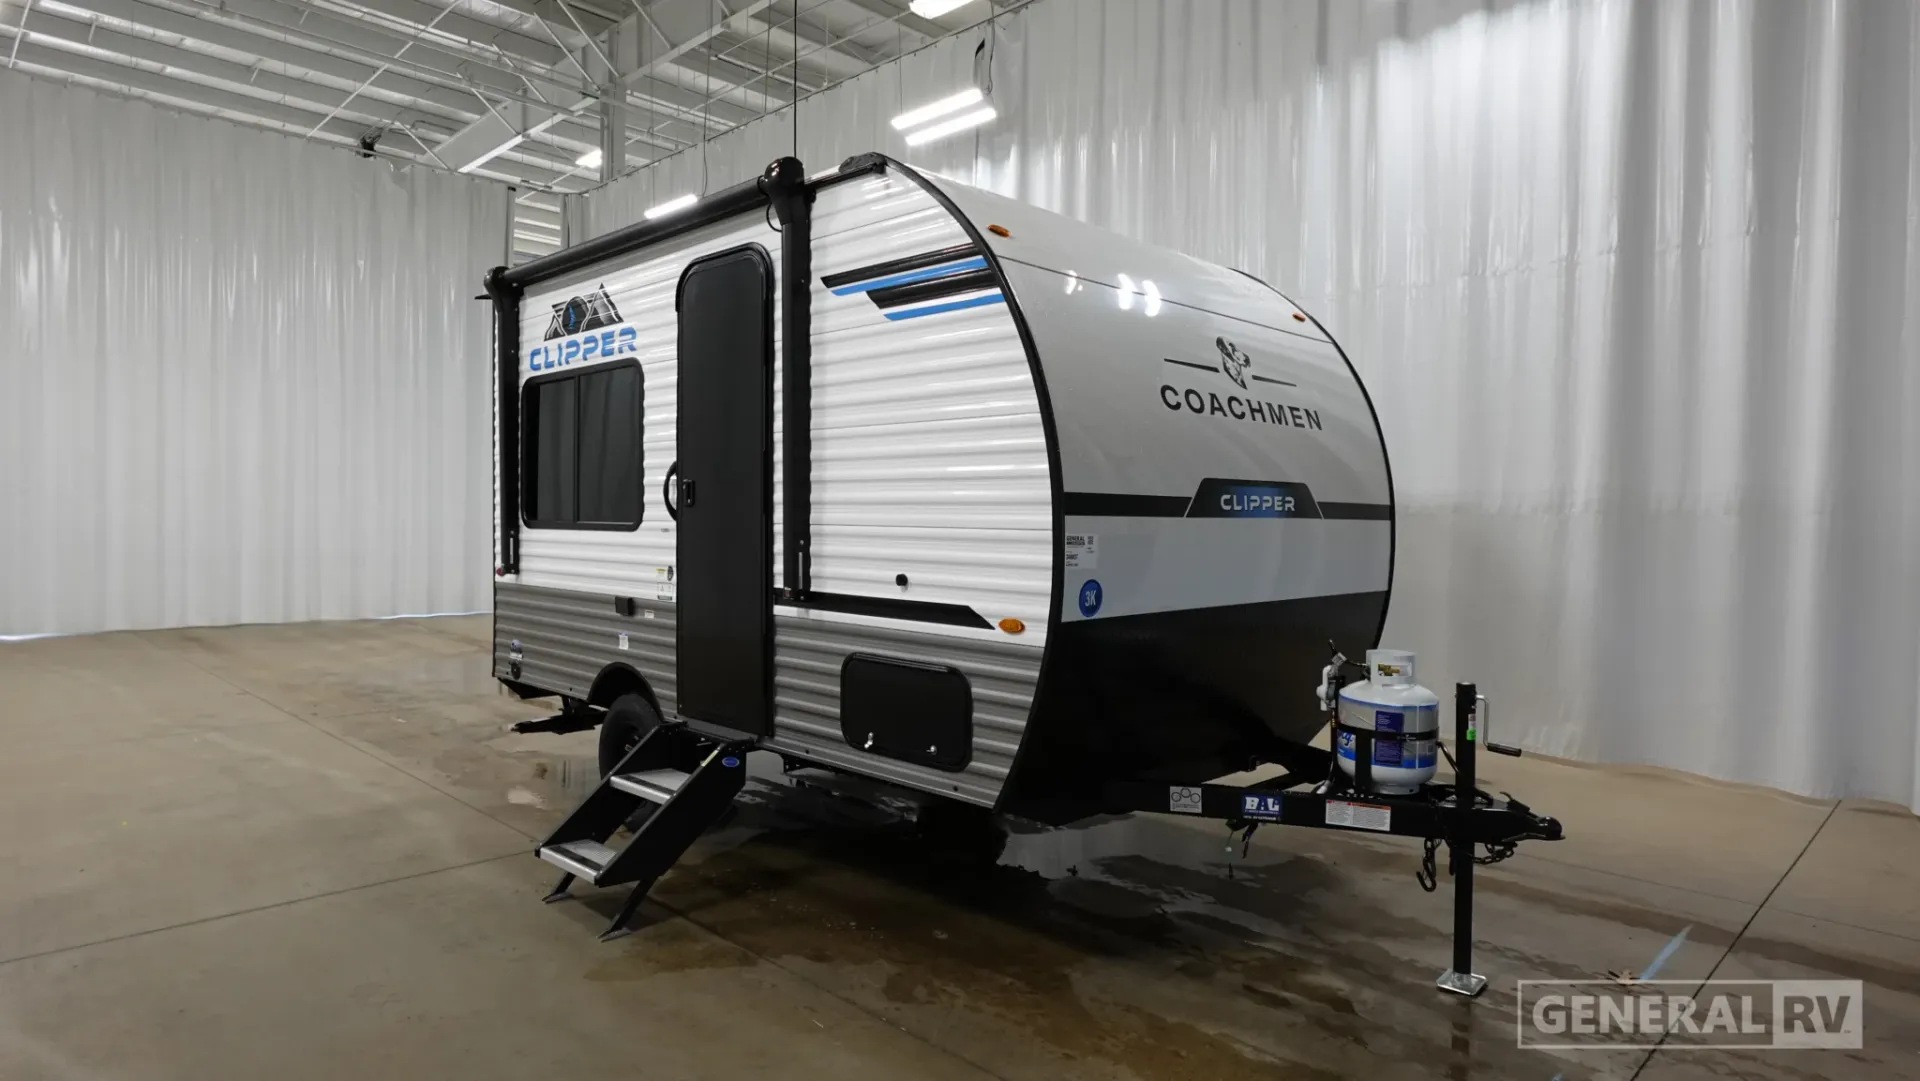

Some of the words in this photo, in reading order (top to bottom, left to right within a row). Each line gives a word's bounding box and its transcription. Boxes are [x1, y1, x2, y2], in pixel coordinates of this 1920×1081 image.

[529, 326, 637, 371] CLIPPER
[1160, 384, 1323, 431] COACHMEN
[1220, 494, 1296, 512] CLIPPER
[1084, 590, 1097, 607] 3K
